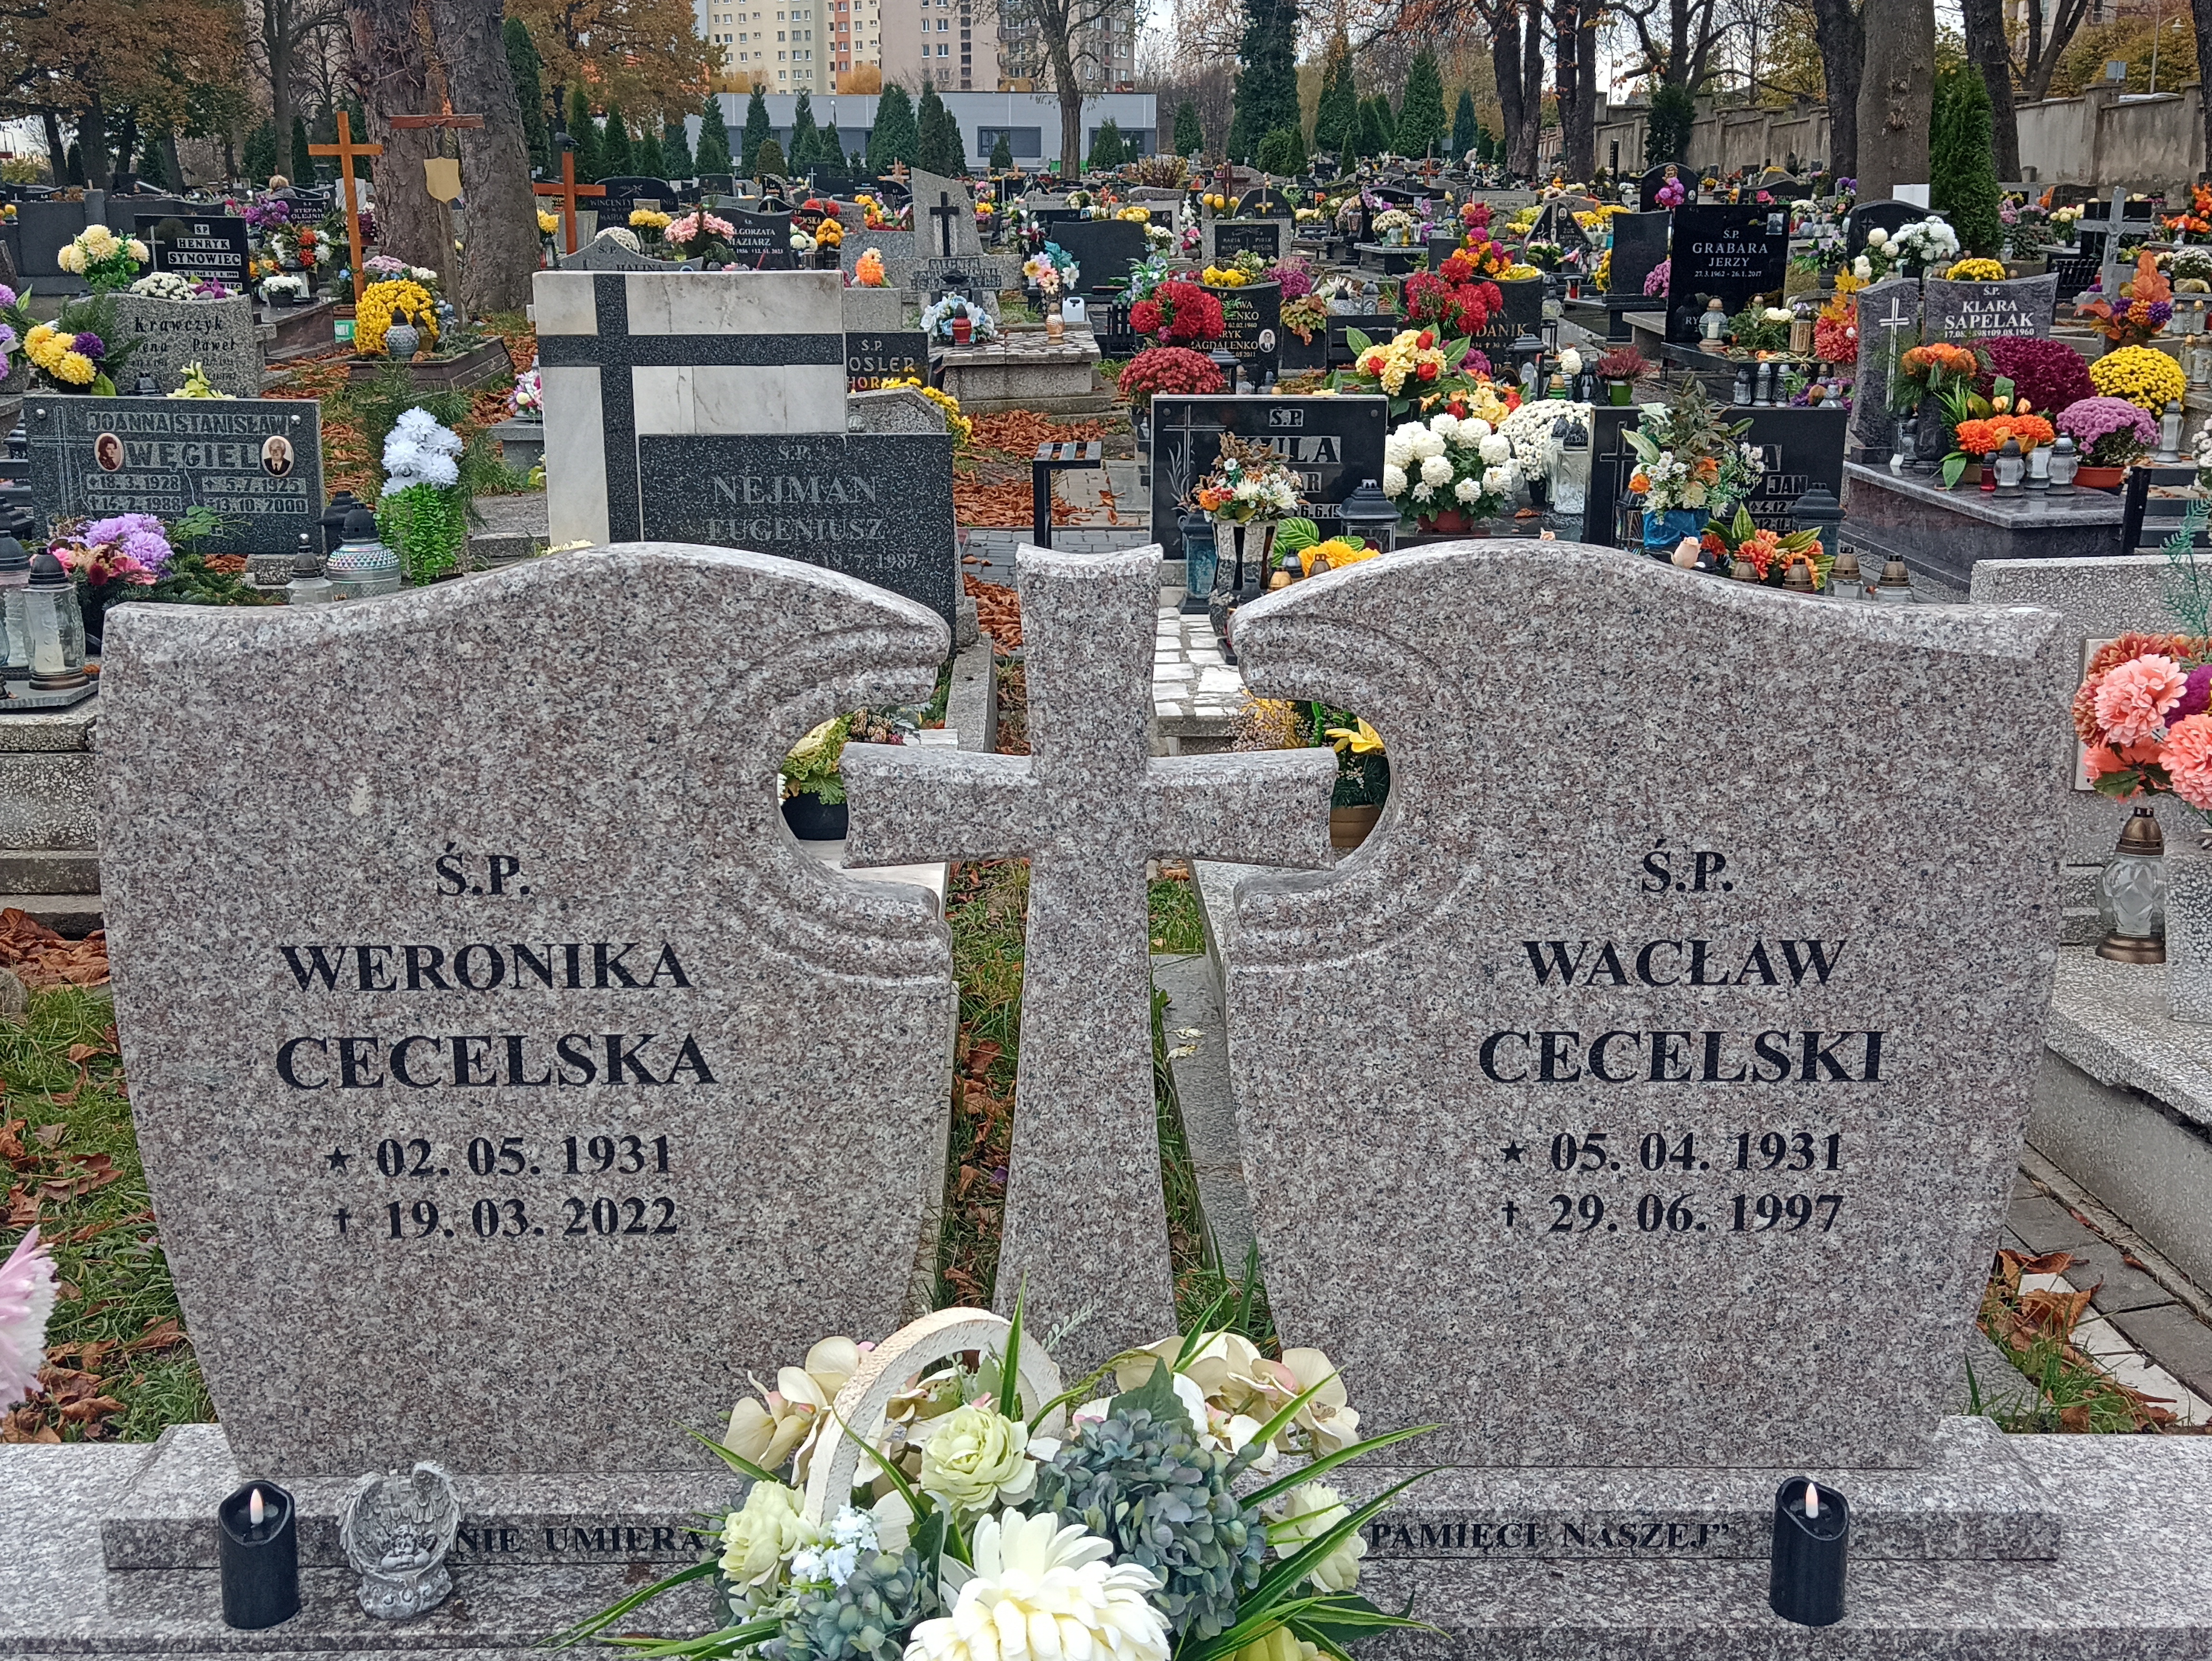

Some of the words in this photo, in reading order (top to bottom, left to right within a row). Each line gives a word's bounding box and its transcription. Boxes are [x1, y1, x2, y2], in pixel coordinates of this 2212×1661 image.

[169, 253, 240, 265] SYNOWIEC
[178, 240, 229, 248] HENRYK
[1692, 243, 1768, 254] GRABARA
[1708, 257, 1750, 267] JERZY
[1944, 312, 2035, 330] SAPELAK
[1962, 299, 2018, 313] KLARA
[134, 316, 222, 334] Krawczyk
[125, 441, 258, 472] WĘGIEL
[714, 476, 877, 504] NEJMAN
[1768, 476, 1807, 494] JAN
[708, 518, 885, 541] EUGENIUSZ
[436, 842, 530, 896] Ś.P.
[1641, 838, 1733, 893] Ś.P.
[279, 942, 693, 993] WERONIKA
[1523, 939, 1847, 987] WACŁAW
[276, 1032, 719, 1090] CECELSKA
[1478, 1030, 1887, 1083] CECELSKI
[562, 1134, 670, 1174] 1931
[1732, 1131, 1842, 1171] 1931
[563, 1196, 677, 1235] 2022
[1729, 1193, 1844, 1232] 1997
[544, 1526, 705, 1553] UMIERA
[1371, 1521, 1537, 1554] PAMIĘCI
